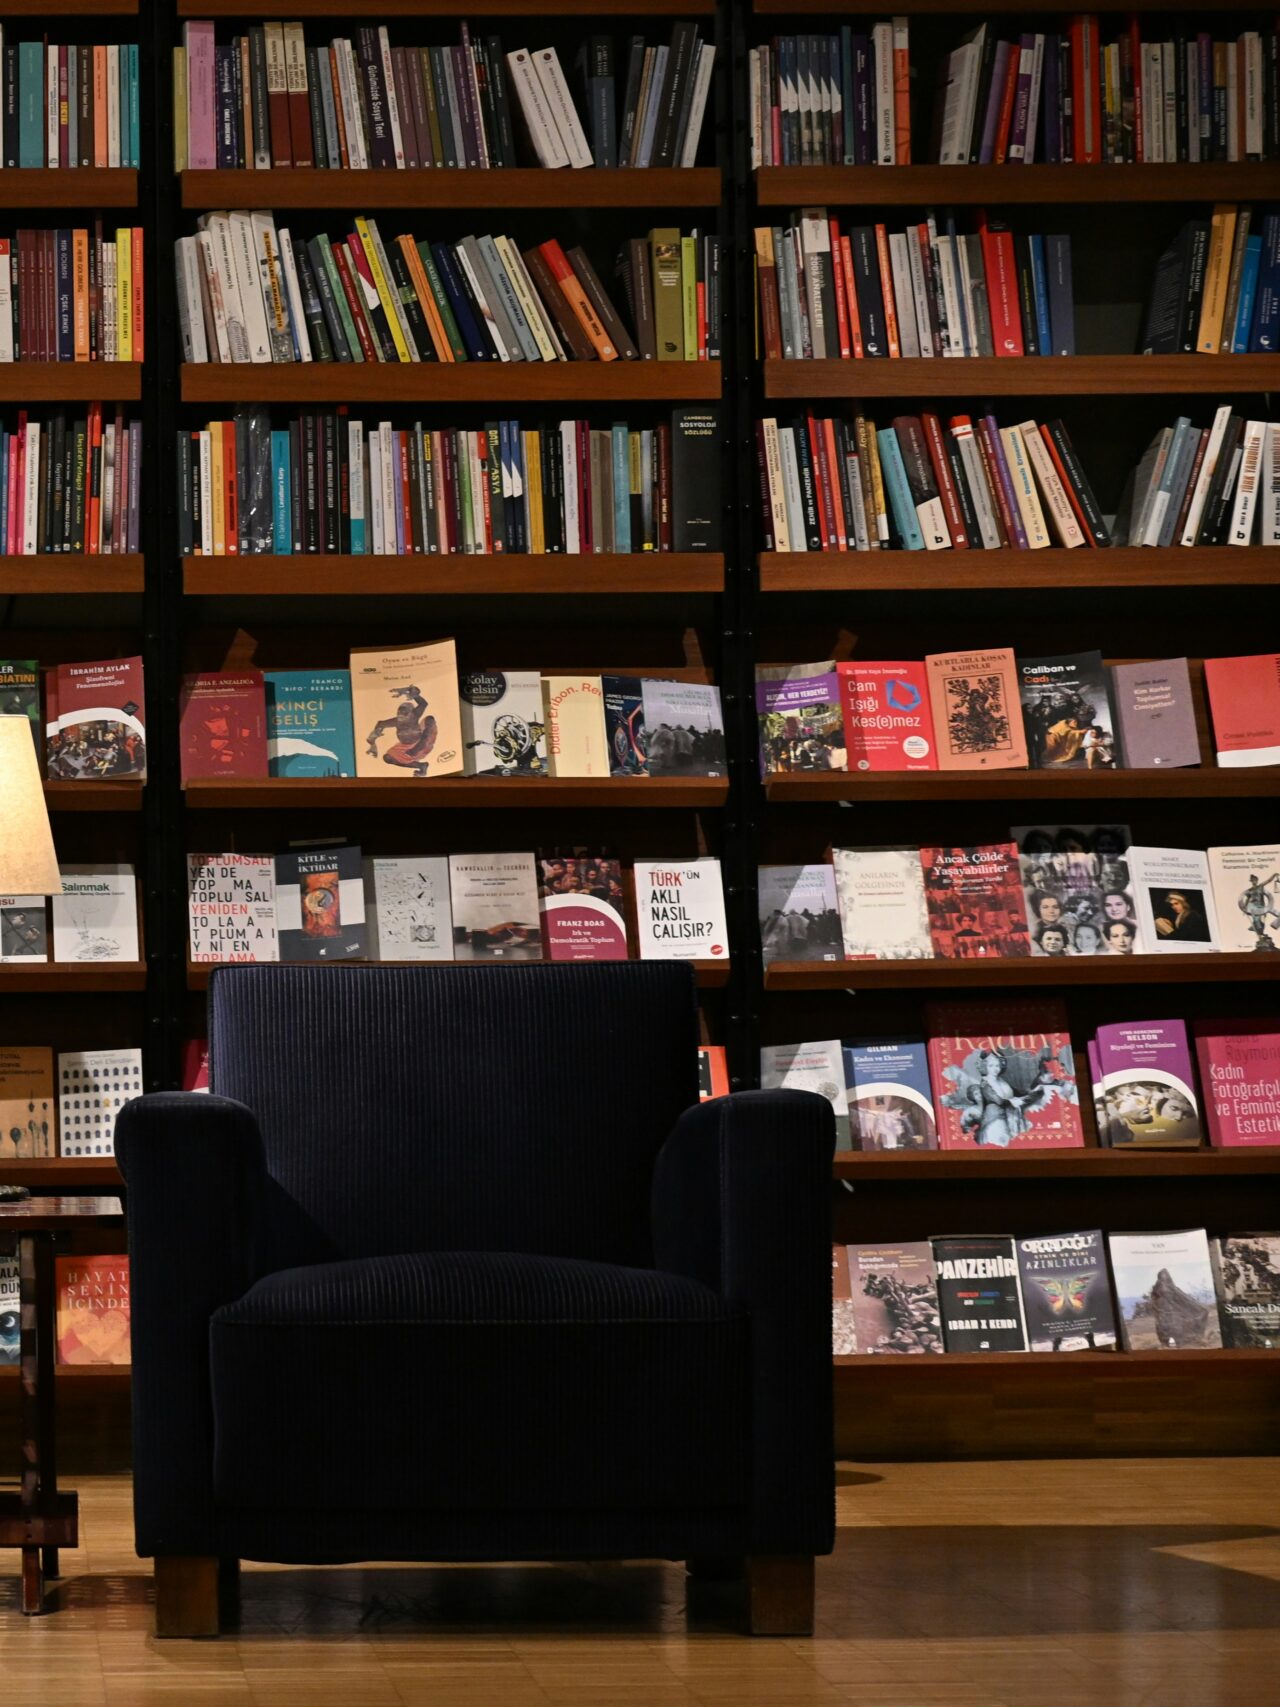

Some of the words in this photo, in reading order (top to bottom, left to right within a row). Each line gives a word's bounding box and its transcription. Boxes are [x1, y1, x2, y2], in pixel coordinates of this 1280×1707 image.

[808, 506, 817, 525] ZEHİR
[933, 656, 980, 667] KURTLARLA
[951, 662, 991, 672] KADINLAR
[70, 666, 105, 676] İBRAHİM
[105, 663, 131, 673] AYLAK
[1023, 665, 1063, 674] Caliban
[310, 678, 344, 686] FRANCO
[847, 680, 877, 692] Cam
[310, 684, 344, 693] BERARDI
[849, 697, 880, 713] Işığı
[852, 714, 921, 730] Kes(e)mez
[298, 854, 327, 864] KİTLE
[935, 854, 971, 865] Ancak
[971, 851, 1005, 864] Çölde
[190, 867, 216, 878] YEN
[221, 867, 237, 878] DE
[298, 862, 339, 873] İKTİDAR
[932, 864, 1010, 877] Yaşayabilirler
[61, 882, 111, 893] Salınmak
[190, 880, 216, 891] TOP
[234, 880, 253, 890] MA
[191, 892, 233, 903] TOPLU
[245, 892, 269, 903] SAL
[650, 889, 680, 905] AKLI
[651, 906, 692, 922] NASIL
[192, 916, 209, 928] TO
[218, 916, 235, 928] LA
[246, 916, 255, 927] A
[556, 920, 582, 928] FRANZ
[584, 919, 605, 927] BOAS
[193, 929, 200, 940] T
[210, 929, 246, 940] PLUM
[255, 928, 264, 939] A
[653, 922, 714, 942] ÇALIŞIR?
[193, 941, 201, 952] Y
[233, 941, 250, 951] EN
[1127, 1034, 1158, 1042] NELSON
[866, 1045, 899, 1053] GILMAN
[853, 1054, 875, 1064] Kadın
[882, 1053, 914, 1063] Ekonomi
[1210, 1063, 1245, 1080] Kadın
[1215, 1102, 1231, 1116] ve
[936, 1255, 1018, 1280] PANZEHİR
[1025, 1256, 1098, 1271] AZINLIKLAR
[68, 1271, 130, 1283] HAYAT
[67, 1284, 130, 1297] SENİN
[1225, 1303, 1265, 1314] Sancak
